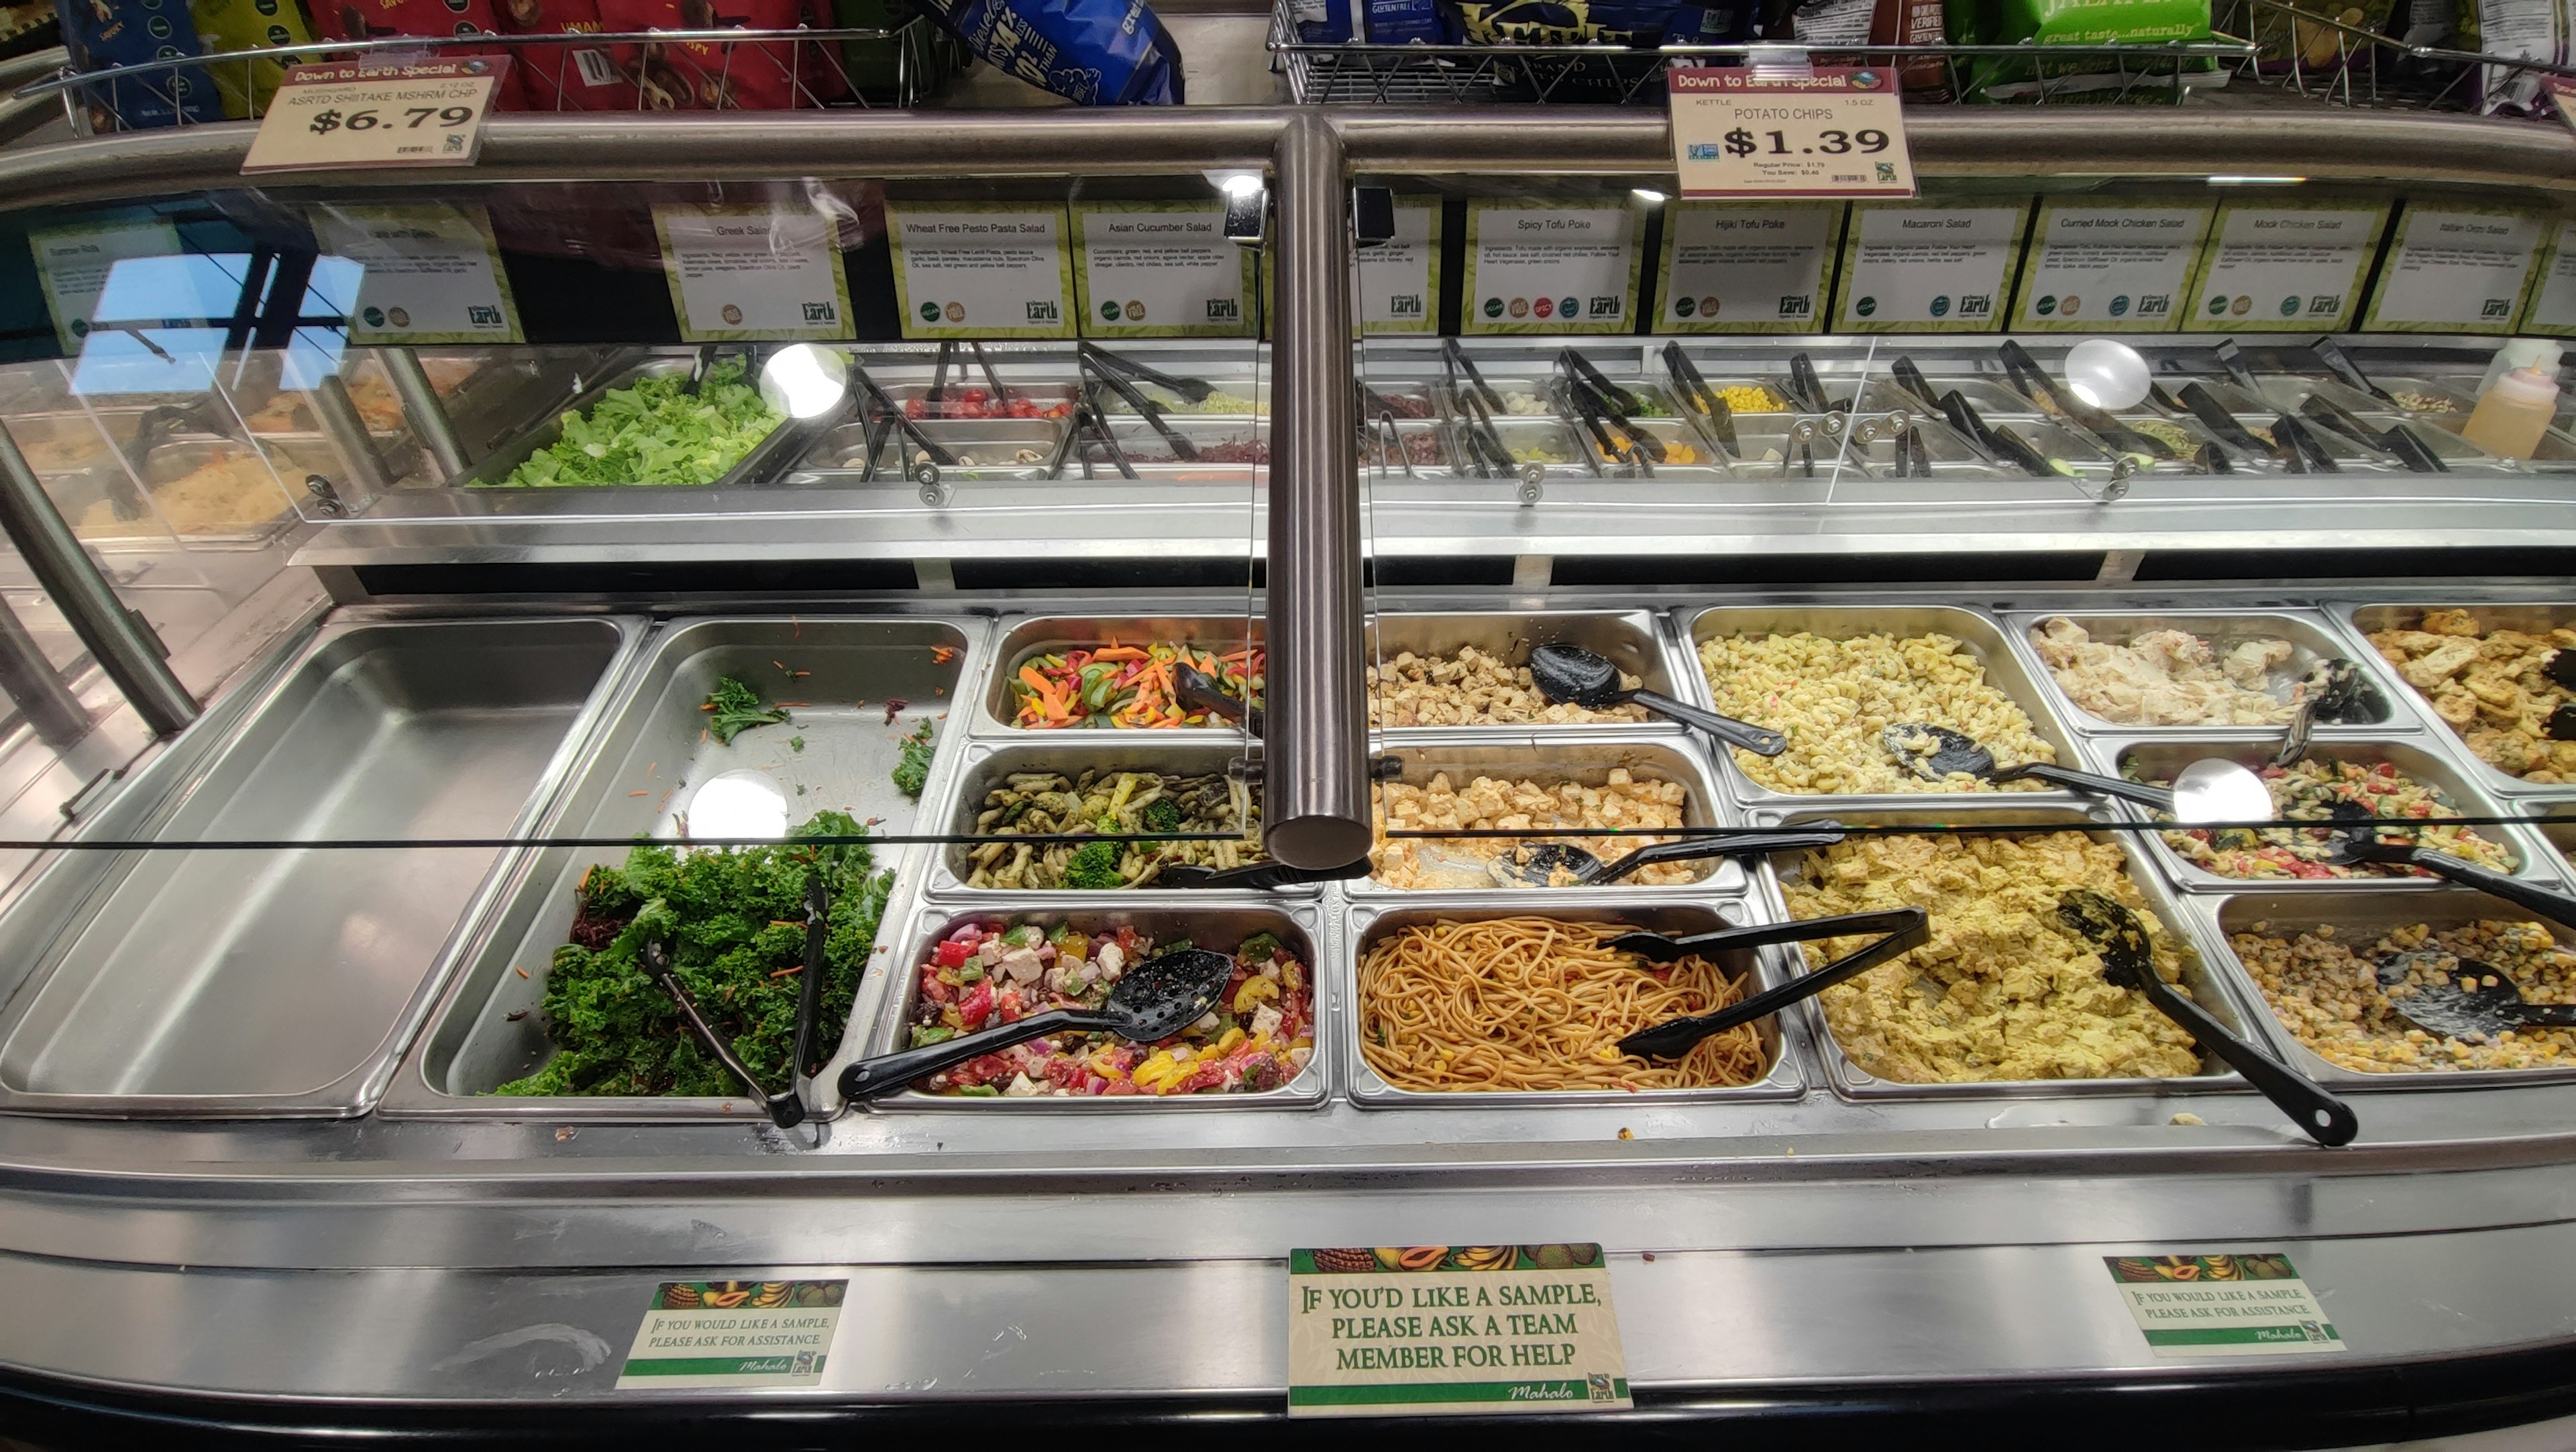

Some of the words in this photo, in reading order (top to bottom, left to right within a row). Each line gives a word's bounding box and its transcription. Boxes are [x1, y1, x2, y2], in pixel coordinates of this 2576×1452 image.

[294, 71, 335, 82] Down
[339, 70, 356, 79] to
[358, 67, 398, 79] Earth
[401, 64, 456, 77] Special
[1678, 74, 1720, 87] Down
[1725, 75, 1742, 87] to
[287, 95, 331, 106] ASRTD
[333, 92, 392, 104] SHIITAKE
[396, 90, 446, 101] MSHRM
[448, 89, 478, 99] CHP
[310, 106, 474, 135] $6.79
[1735, 109, 1789, 119] POTATO
[1792, 109, 1833, 119] CHIPS
[1724, 127, 1890, 158] $1.39
[716, 226, 743, 236] Greek
[906, 224, 936, 233] Wheat
[938, 224, 959, 233] Free
[963, 224, 988, 233] Pesto
[991, 224, 1017, 233] Pasta
[1020, 223, 1045, 233] Salad
[1108, 223, 1134, 232] Asian
[1137, 223, 1183, 232] Cucumber
[1186, 223, 1212, 231] Salad
[1518, 219, 1543, 231] Spicy
[1545, 219, 1565, 229] Tofu
[1568, 219, 1591, 229] Poke
[1740, 219, 1760, 229] Tofu
[1762, 220, 1785, 229] Poke
[1902, 219, 1944, 228] Macaroni
[1945, 219, 1972, 228] Salad
[802, 302, 835, 321] Earth
[1026, 300, 1058, 319] Earth
[1207, 298, 1238, 317] Earth
[1391, 294, 1421, 313] Earth
[1589, 295, 1621, 314] Earth
[1779, 295, 1811, 313] Earth
[1959, 294, 1991, 313] Earth
[2137, 294, 2169, 313] Earth
[1301, 1286, 1322, 1314] IF
[1328, 1286, 1403, 1309] YOU'D
[1412, 1287, 1470, 1308] LIKE
[1476, 1288, 1493, 1306] A
[1499, 1284, 1602, 1307] SAMPLE,
[2131, 1291, 2145, 1306] IF
[2146, 1292, 2171, 1302] YOU
[2174, 1292, 2214, 1302] WOULD
[2219, 1291, 2246, 1301] LIKE
[2247, 1291, 2255, 1300] A
[2257, 1289, 2306, 1300] SAMPLE,
[2145, 1308, 2190, 1319] PLEASE
[2190, 1308, 2213, 1318] ASK
[2214, 1306, 2239, 1317] FOR
[650, 1318, 665, 1334] IF
[668, 1320, 692, 1331] YOU
[694, 1320, 736, 1329] WOULD
[740, 1319, 768, 1329] LIKE
[770, 1319, 777, 1329] A
[782, 1318, 830, 1329] SAMPLE,
[1332, 1317, 1423, 1339] PLEASE
[1429, 1316, 1479, 1337] ASK
[1484, 1315, 1501, 1336] A
[1506, 1313, 1578, 1335] TEAM
[2254, 1327, 2302, 1341] Mahalo
[649, 1337, 692, 1347] PLEASE
[694, 1336, 718, 1347] ASK
[720, 1335, 745, 1346] FOR
[747, 1335, 820, 1345] ASSISTANCE
[1336, 1347, 1448, 1370] MEMBER
[1453, 1345, 1508, 1367] FOR
[1511, 1343, 1576, 1366] HELP
[739, 1361, 788, 1371] Mahalo
[1508, 1382, 1574, 1400] Mahalo
